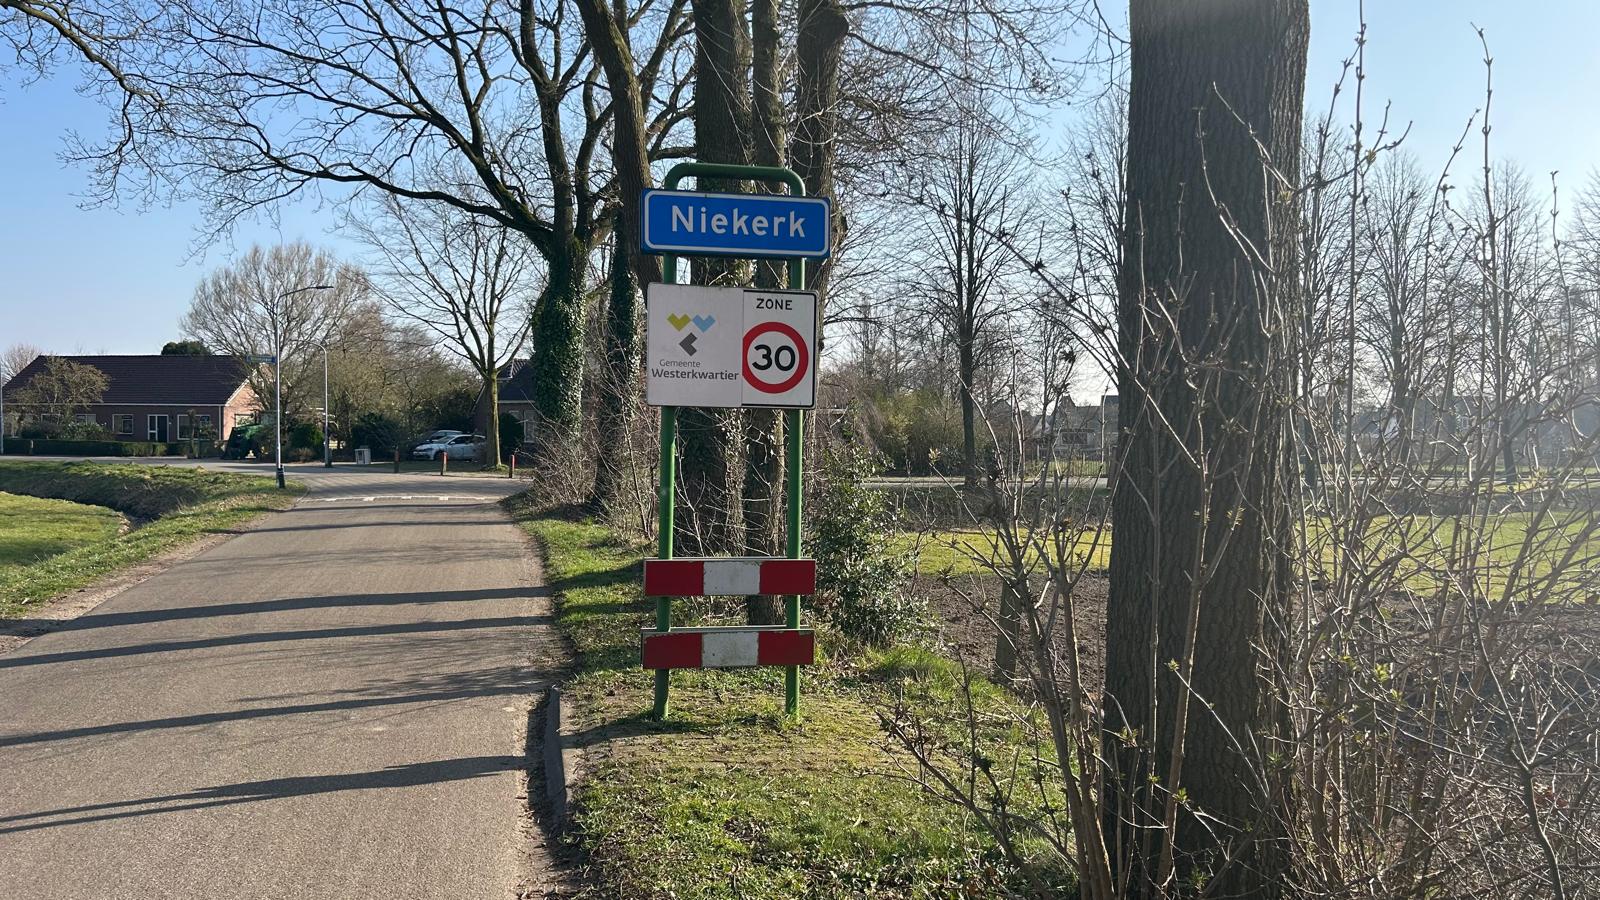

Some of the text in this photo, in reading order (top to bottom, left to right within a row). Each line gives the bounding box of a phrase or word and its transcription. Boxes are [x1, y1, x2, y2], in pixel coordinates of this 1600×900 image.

[671, 205, 806, 238] Niekerk
[756, 298, 793, 311] ZONE
[659, 358, 701, 368] Gemeente
[752, 344, 796, 371] 30
[651, 368, 740, 381] Westerkwartier
